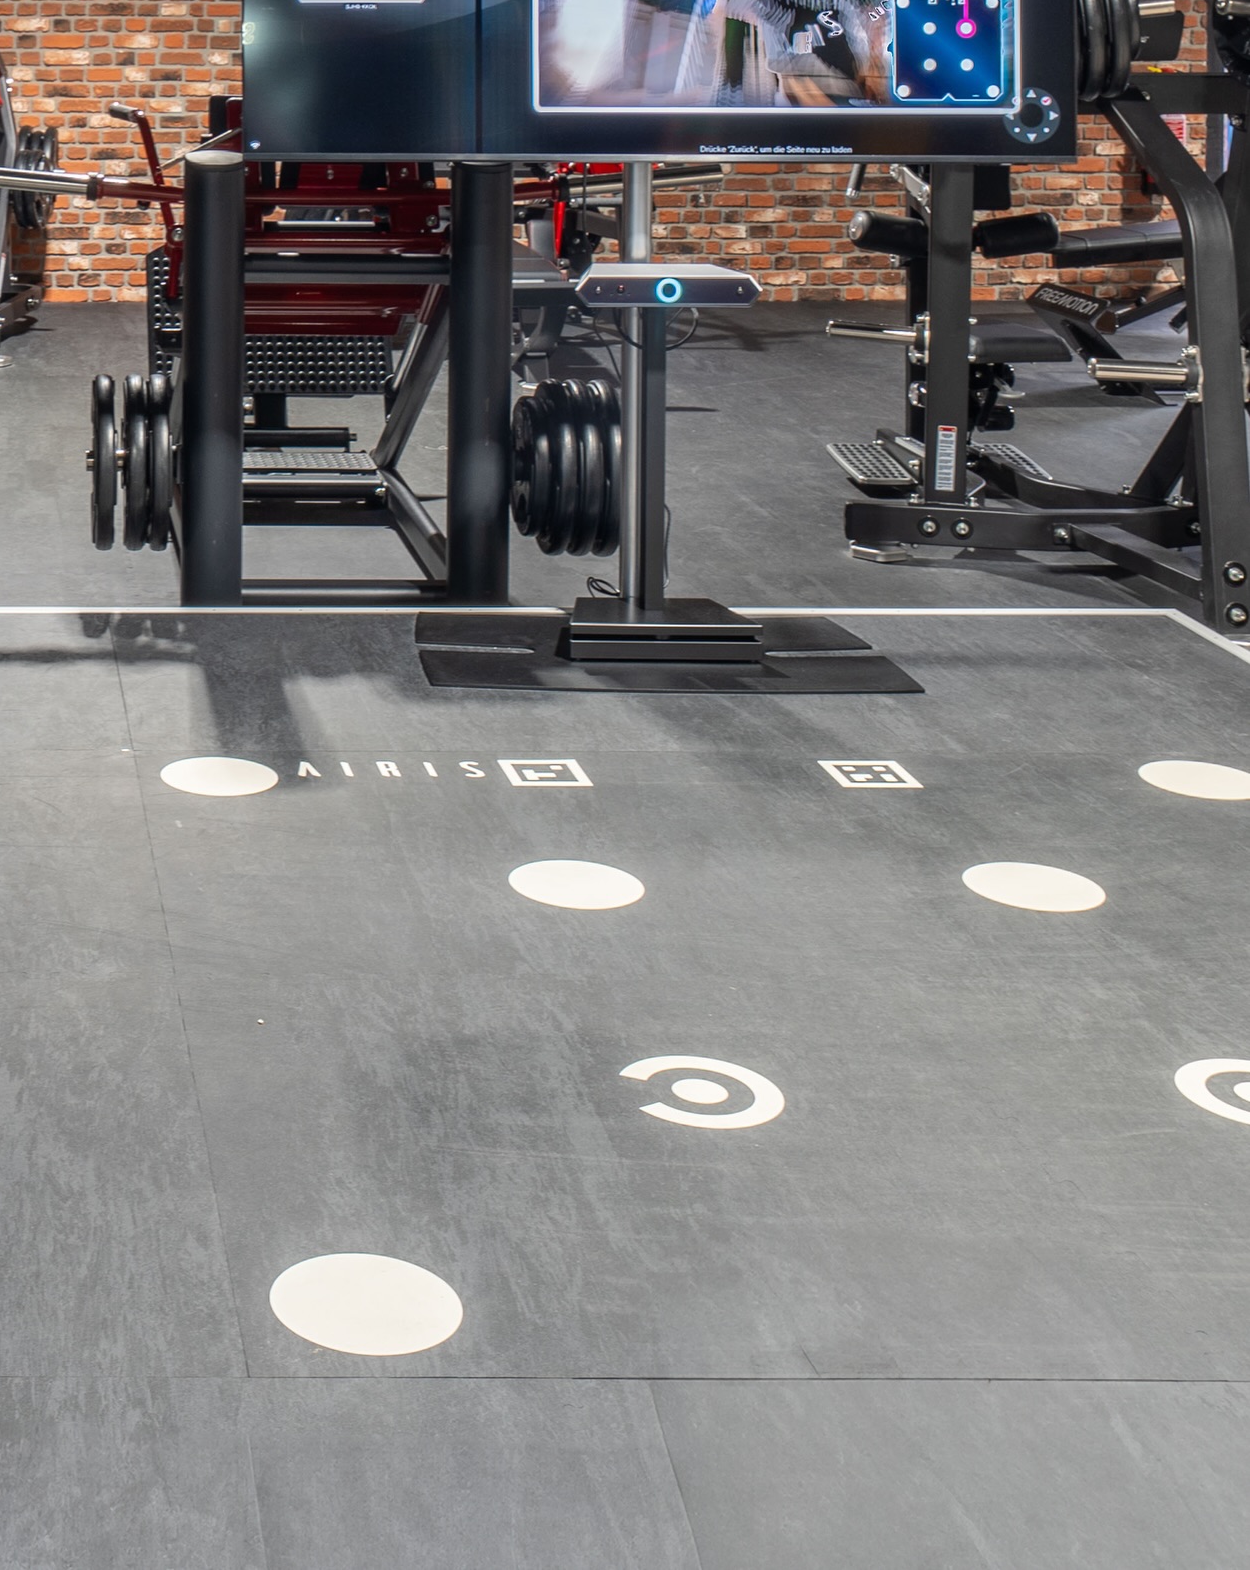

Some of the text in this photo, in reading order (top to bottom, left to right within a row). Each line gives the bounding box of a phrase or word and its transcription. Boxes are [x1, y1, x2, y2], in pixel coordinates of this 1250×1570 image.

[700, 145, 727, 154] Drücke
[773, 145, 785, 154] die
[786, 145, 805, 154] Seite
[832, 145, 853, 154] laden
[1035, 287, 1099, 316] FREEMOTION
[297, 761, 485, 777] AIRIS
